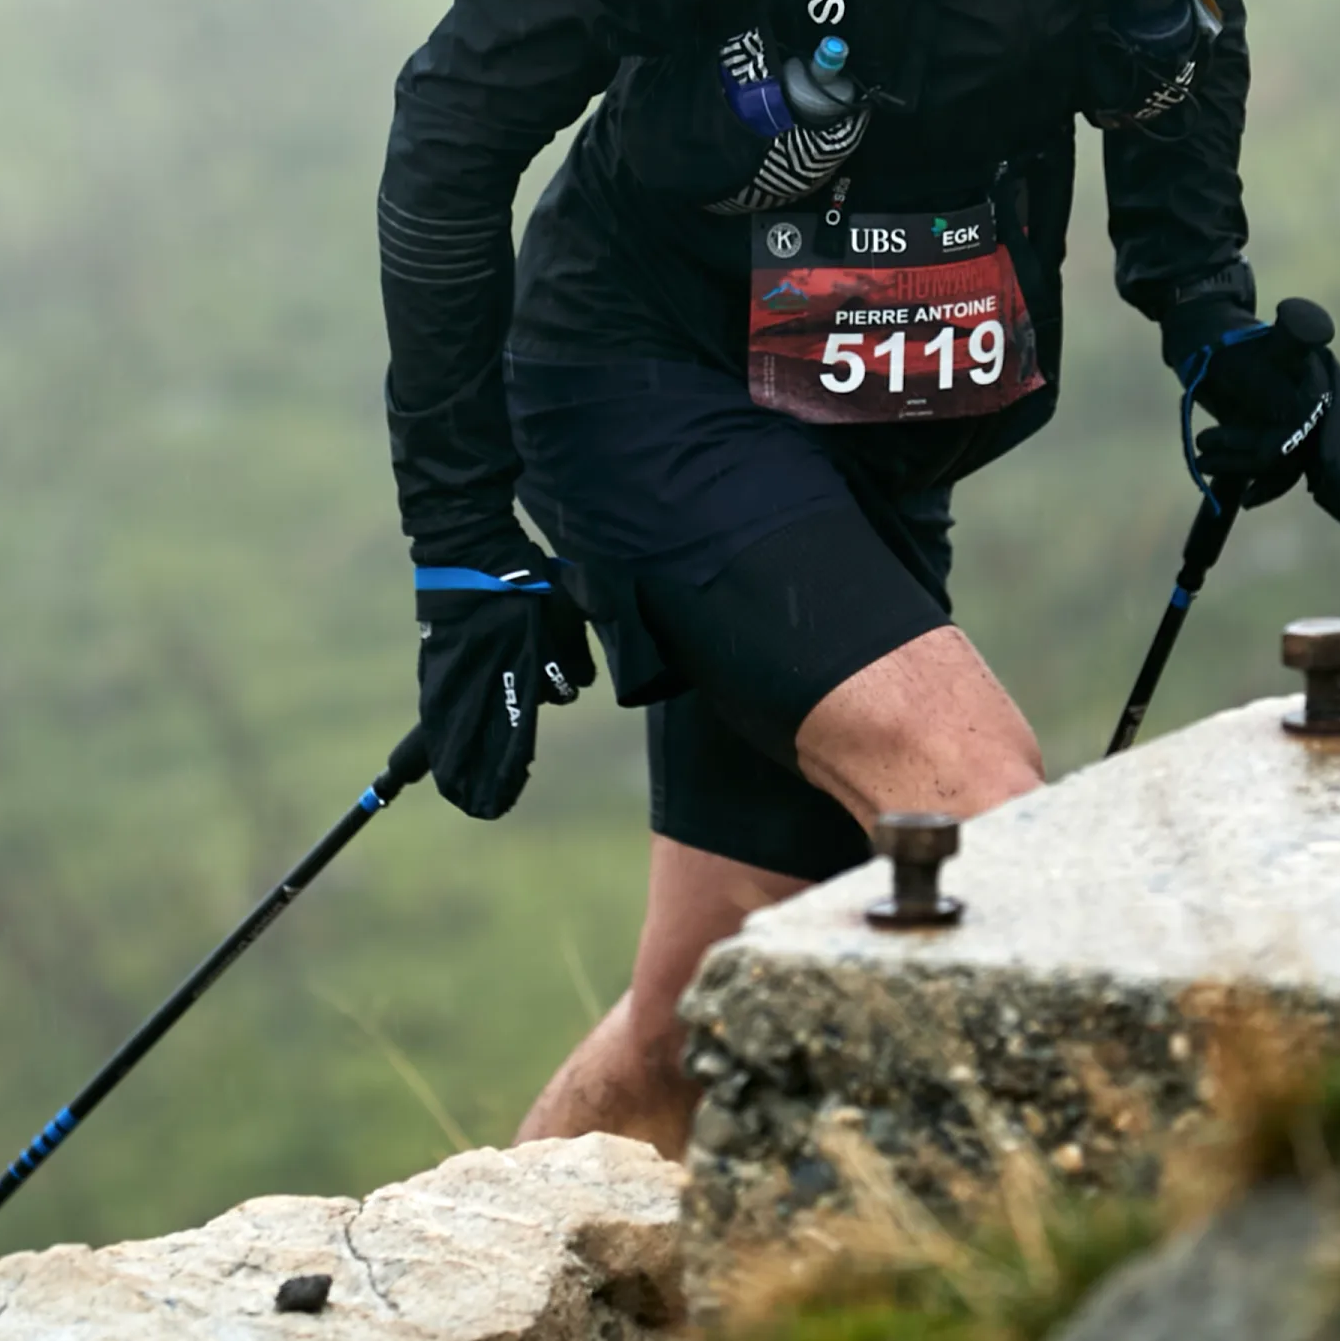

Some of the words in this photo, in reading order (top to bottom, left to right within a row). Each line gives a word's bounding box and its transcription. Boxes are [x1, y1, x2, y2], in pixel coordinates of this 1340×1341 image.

[850, 228, 907, 253] UBS
[942, 224, 980, 247] EGK
[835, 308, 909, 326] PIERRE
[914, 295, 997, 323] ANTOINE
[819, 319, 1006, 394] 5119
